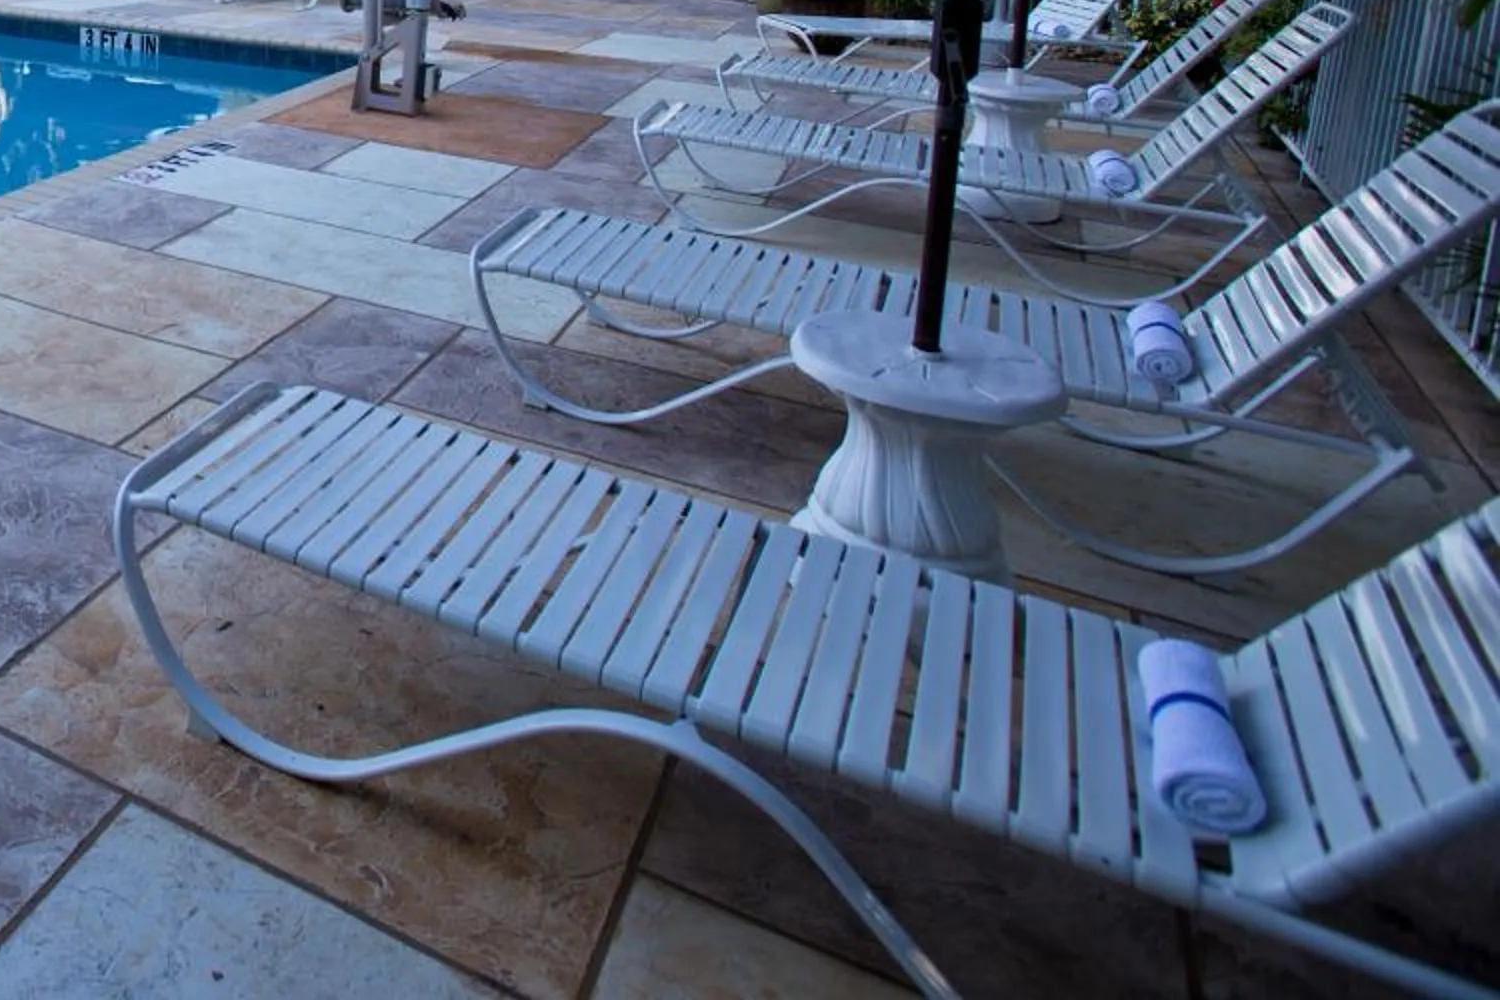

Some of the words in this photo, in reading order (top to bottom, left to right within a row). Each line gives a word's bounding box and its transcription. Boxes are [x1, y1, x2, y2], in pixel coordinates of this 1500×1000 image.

[85, 29, 93, 47] 3
[101, 30, 117, 48] FT
[124, 33, 132, 50] 4
[141, 35, 157, 53] IN
